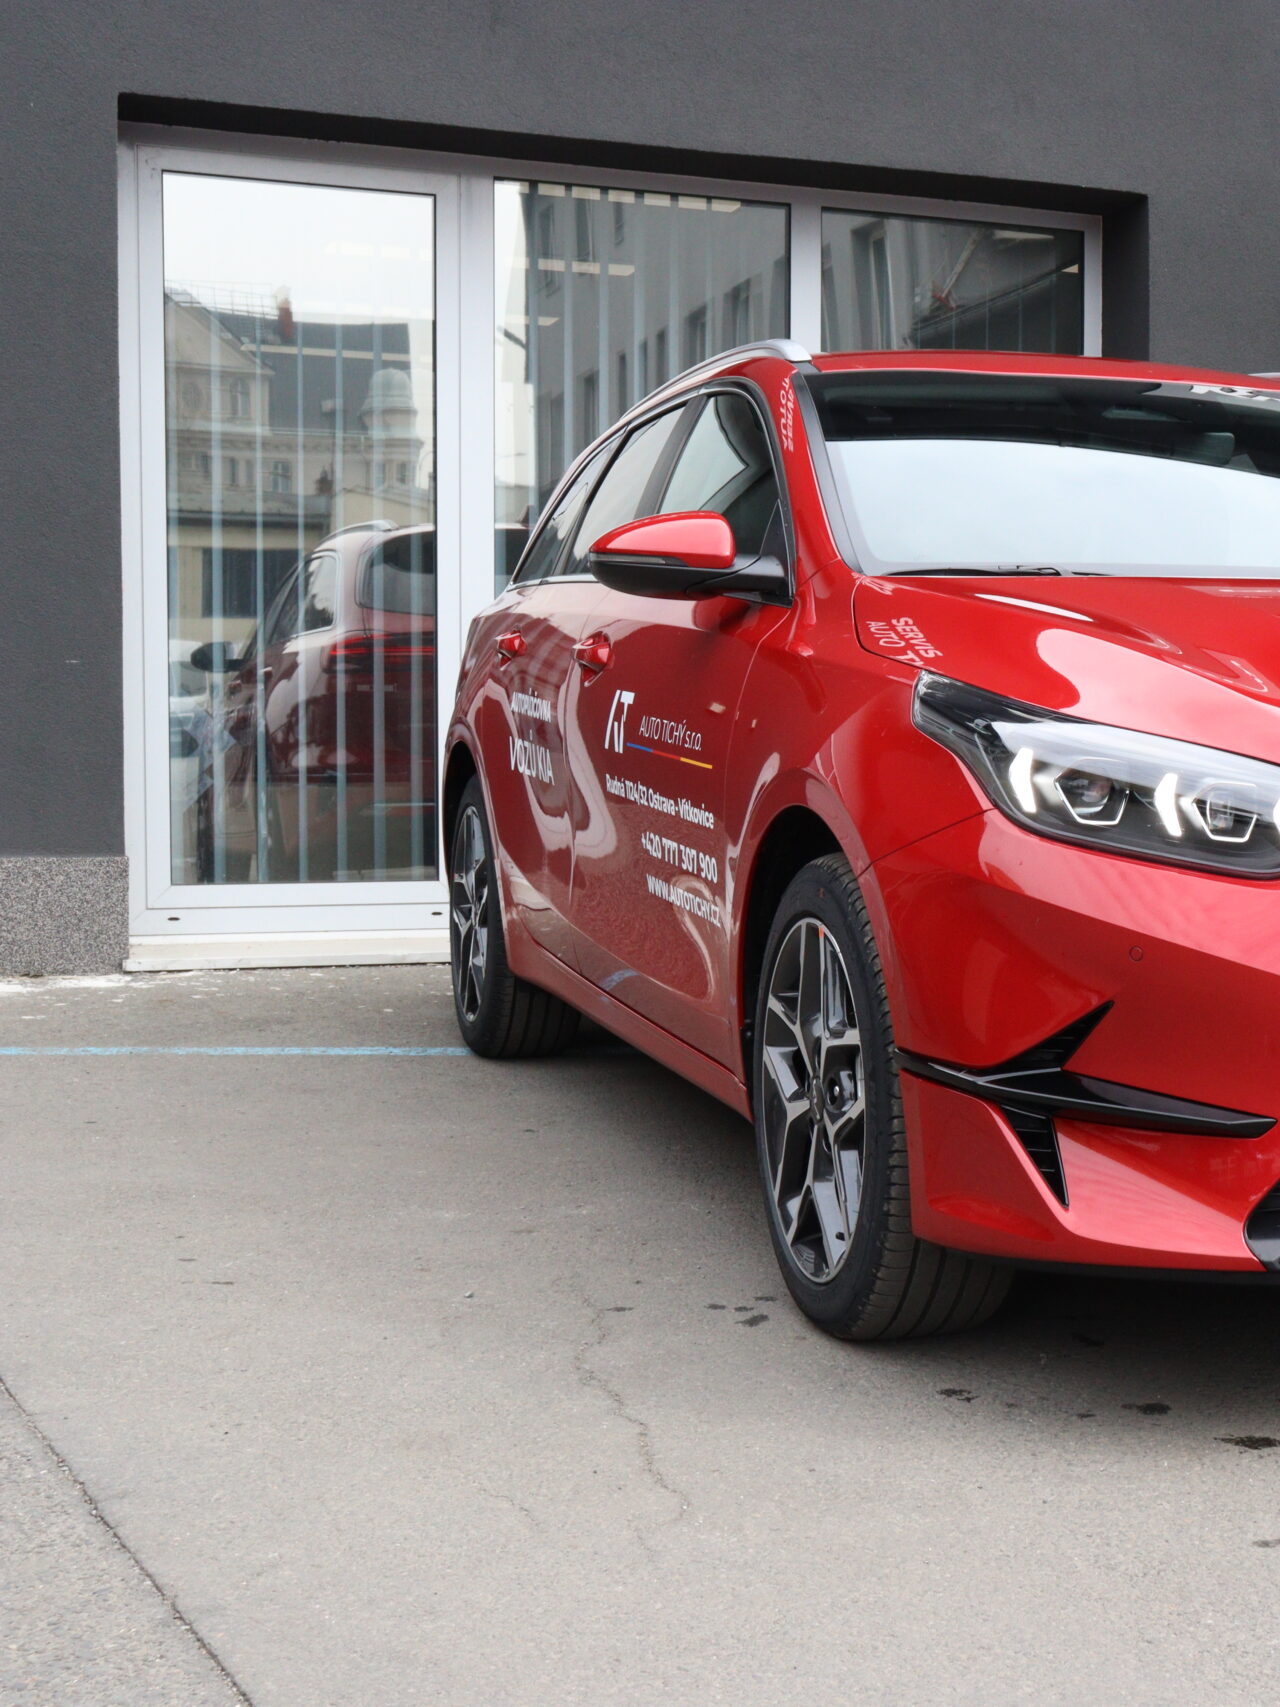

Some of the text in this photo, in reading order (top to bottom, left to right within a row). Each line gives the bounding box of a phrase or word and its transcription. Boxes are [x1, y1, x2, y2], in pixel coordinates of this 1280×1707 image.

[865, 621, 906, 648] AUTO
[891, 616, 944, 658] SERVIS
[639, 715, 702, 751] AUTO TICHÝ s.r.o.
[509, 729, 555, 786] VOZŮ KIA
[605, 773, 625, 797] Rudná
[641, 831, 718, 884] +420 777 307 900
